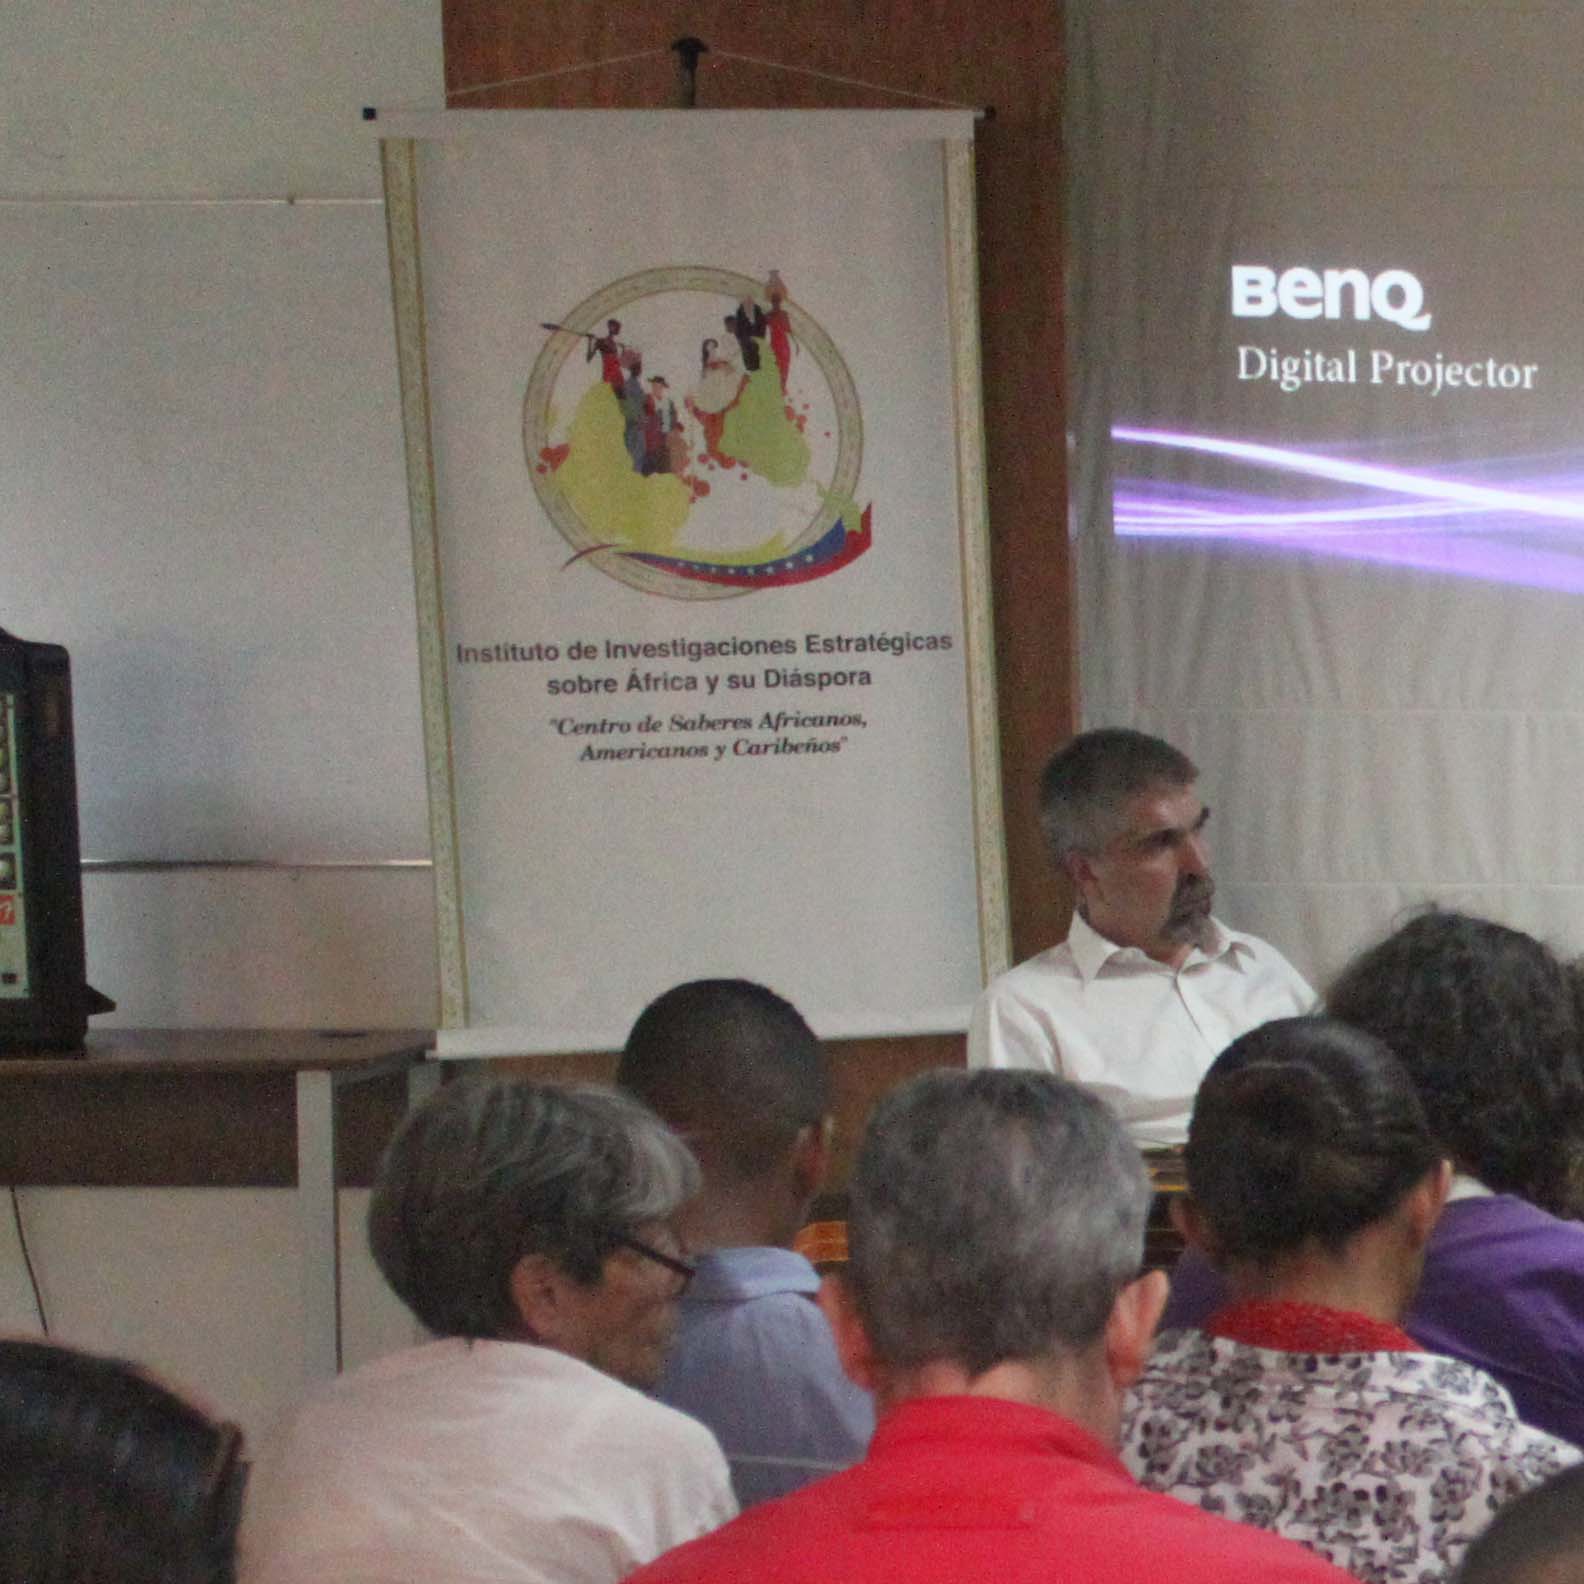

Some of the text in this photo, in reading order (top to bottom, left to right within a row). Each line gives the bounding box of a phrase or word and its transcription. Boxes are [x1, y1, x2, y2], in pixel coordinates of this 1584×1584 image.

[1231, 265, 1432, 332] BenQ
[1238, 345, 1538, 396] Digital Projector
[457, 632, 953, 663] Instituto de Investigaciones Estratégicas
[547, 667, 872, 695] sobre África y su Diáspora
[550, 710, 867, 736] "Centro de Saberes Africanos,
[580, 735, 848, 762] Americanos y Caribeños"
